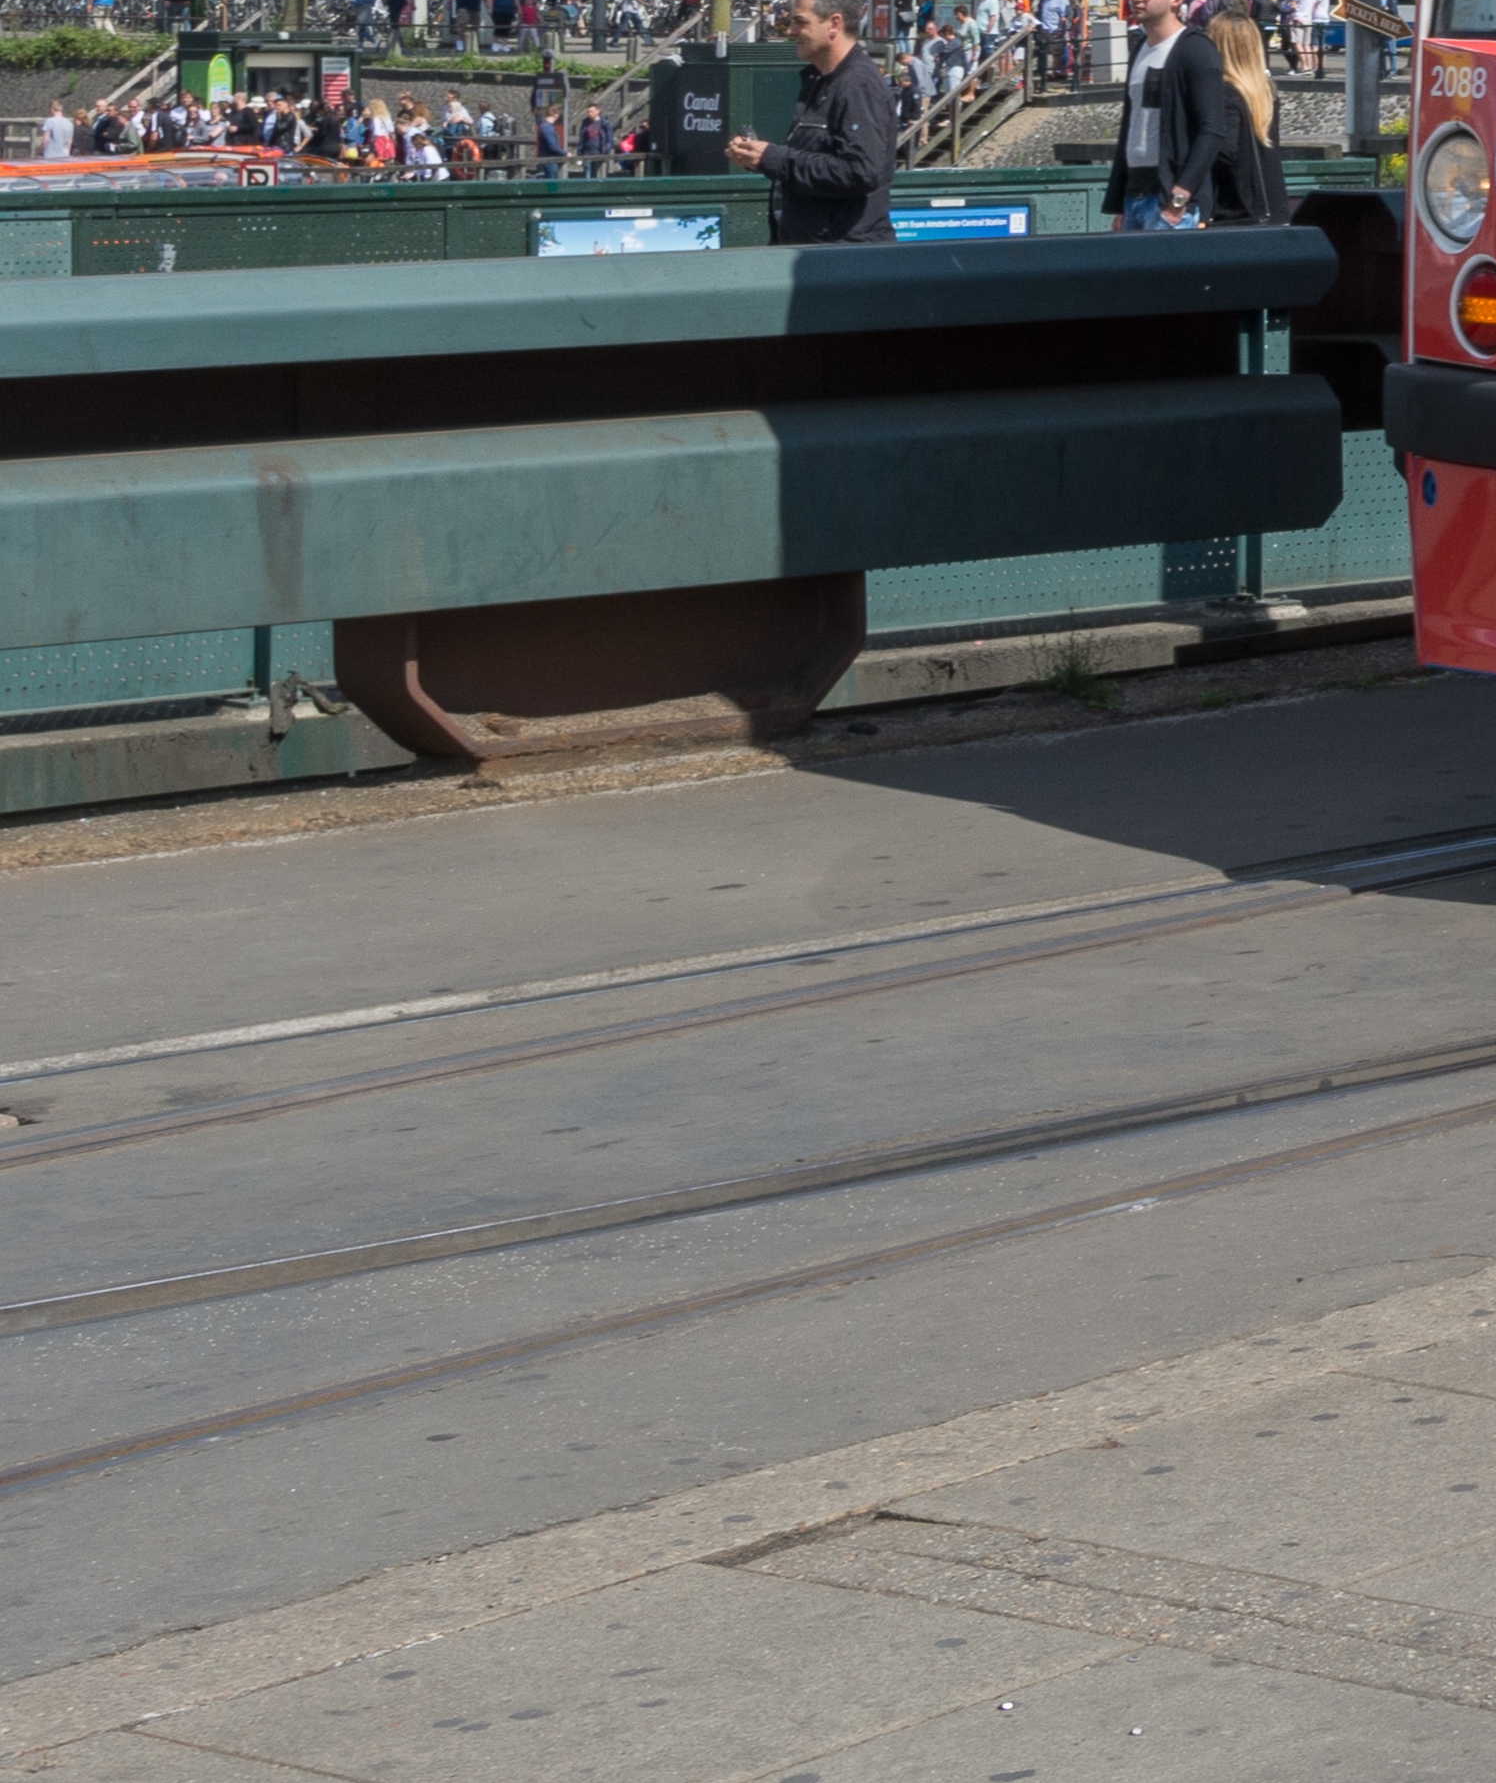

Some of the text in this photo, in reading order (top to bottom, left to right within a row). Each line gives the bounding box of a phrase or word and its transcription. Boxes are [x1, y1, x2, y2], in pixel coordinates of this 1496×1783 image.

[1430, 64, 1487, 100] 2088
[683, 92, 721, 112] Canal
[683, 113, 722, 132] Cruise
